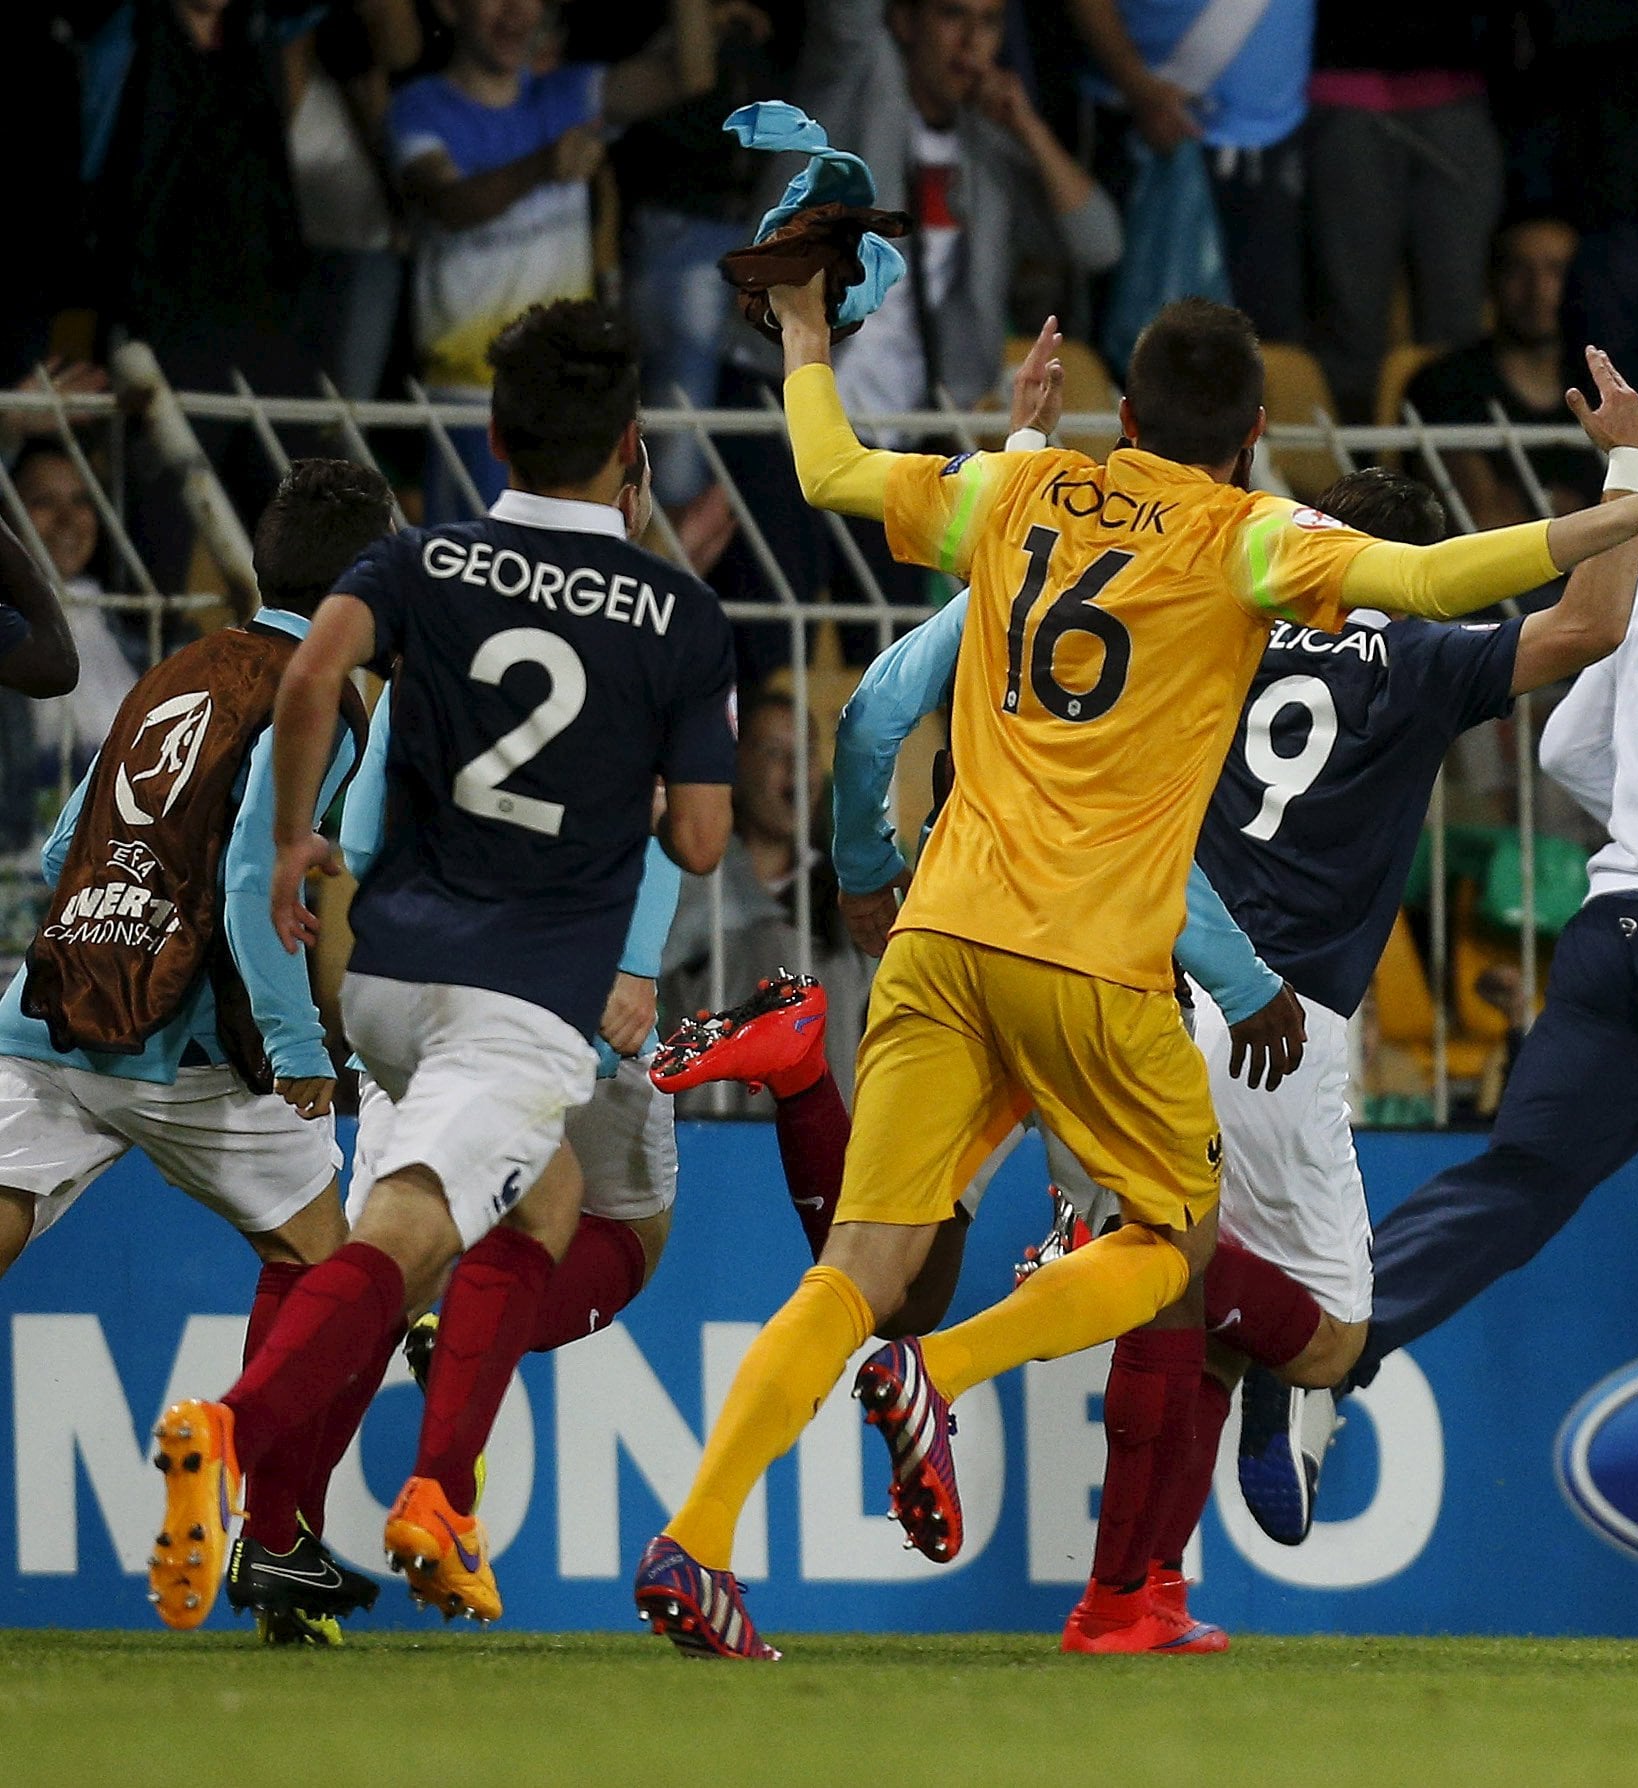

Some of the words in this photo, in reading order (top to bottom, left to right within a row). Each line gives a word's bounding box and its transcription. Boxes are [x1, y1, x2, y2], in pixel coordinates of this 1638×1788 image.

[1041, 469, 1181, 534] KOCIK
[422, 537, 676, 636] GEORGEN
[1001, 523, 1135, 724] 16
[453, 626, 588, 837] 2
[1239, 673, 1339, 842] 9
[112, 847, 156, 878] EFA
